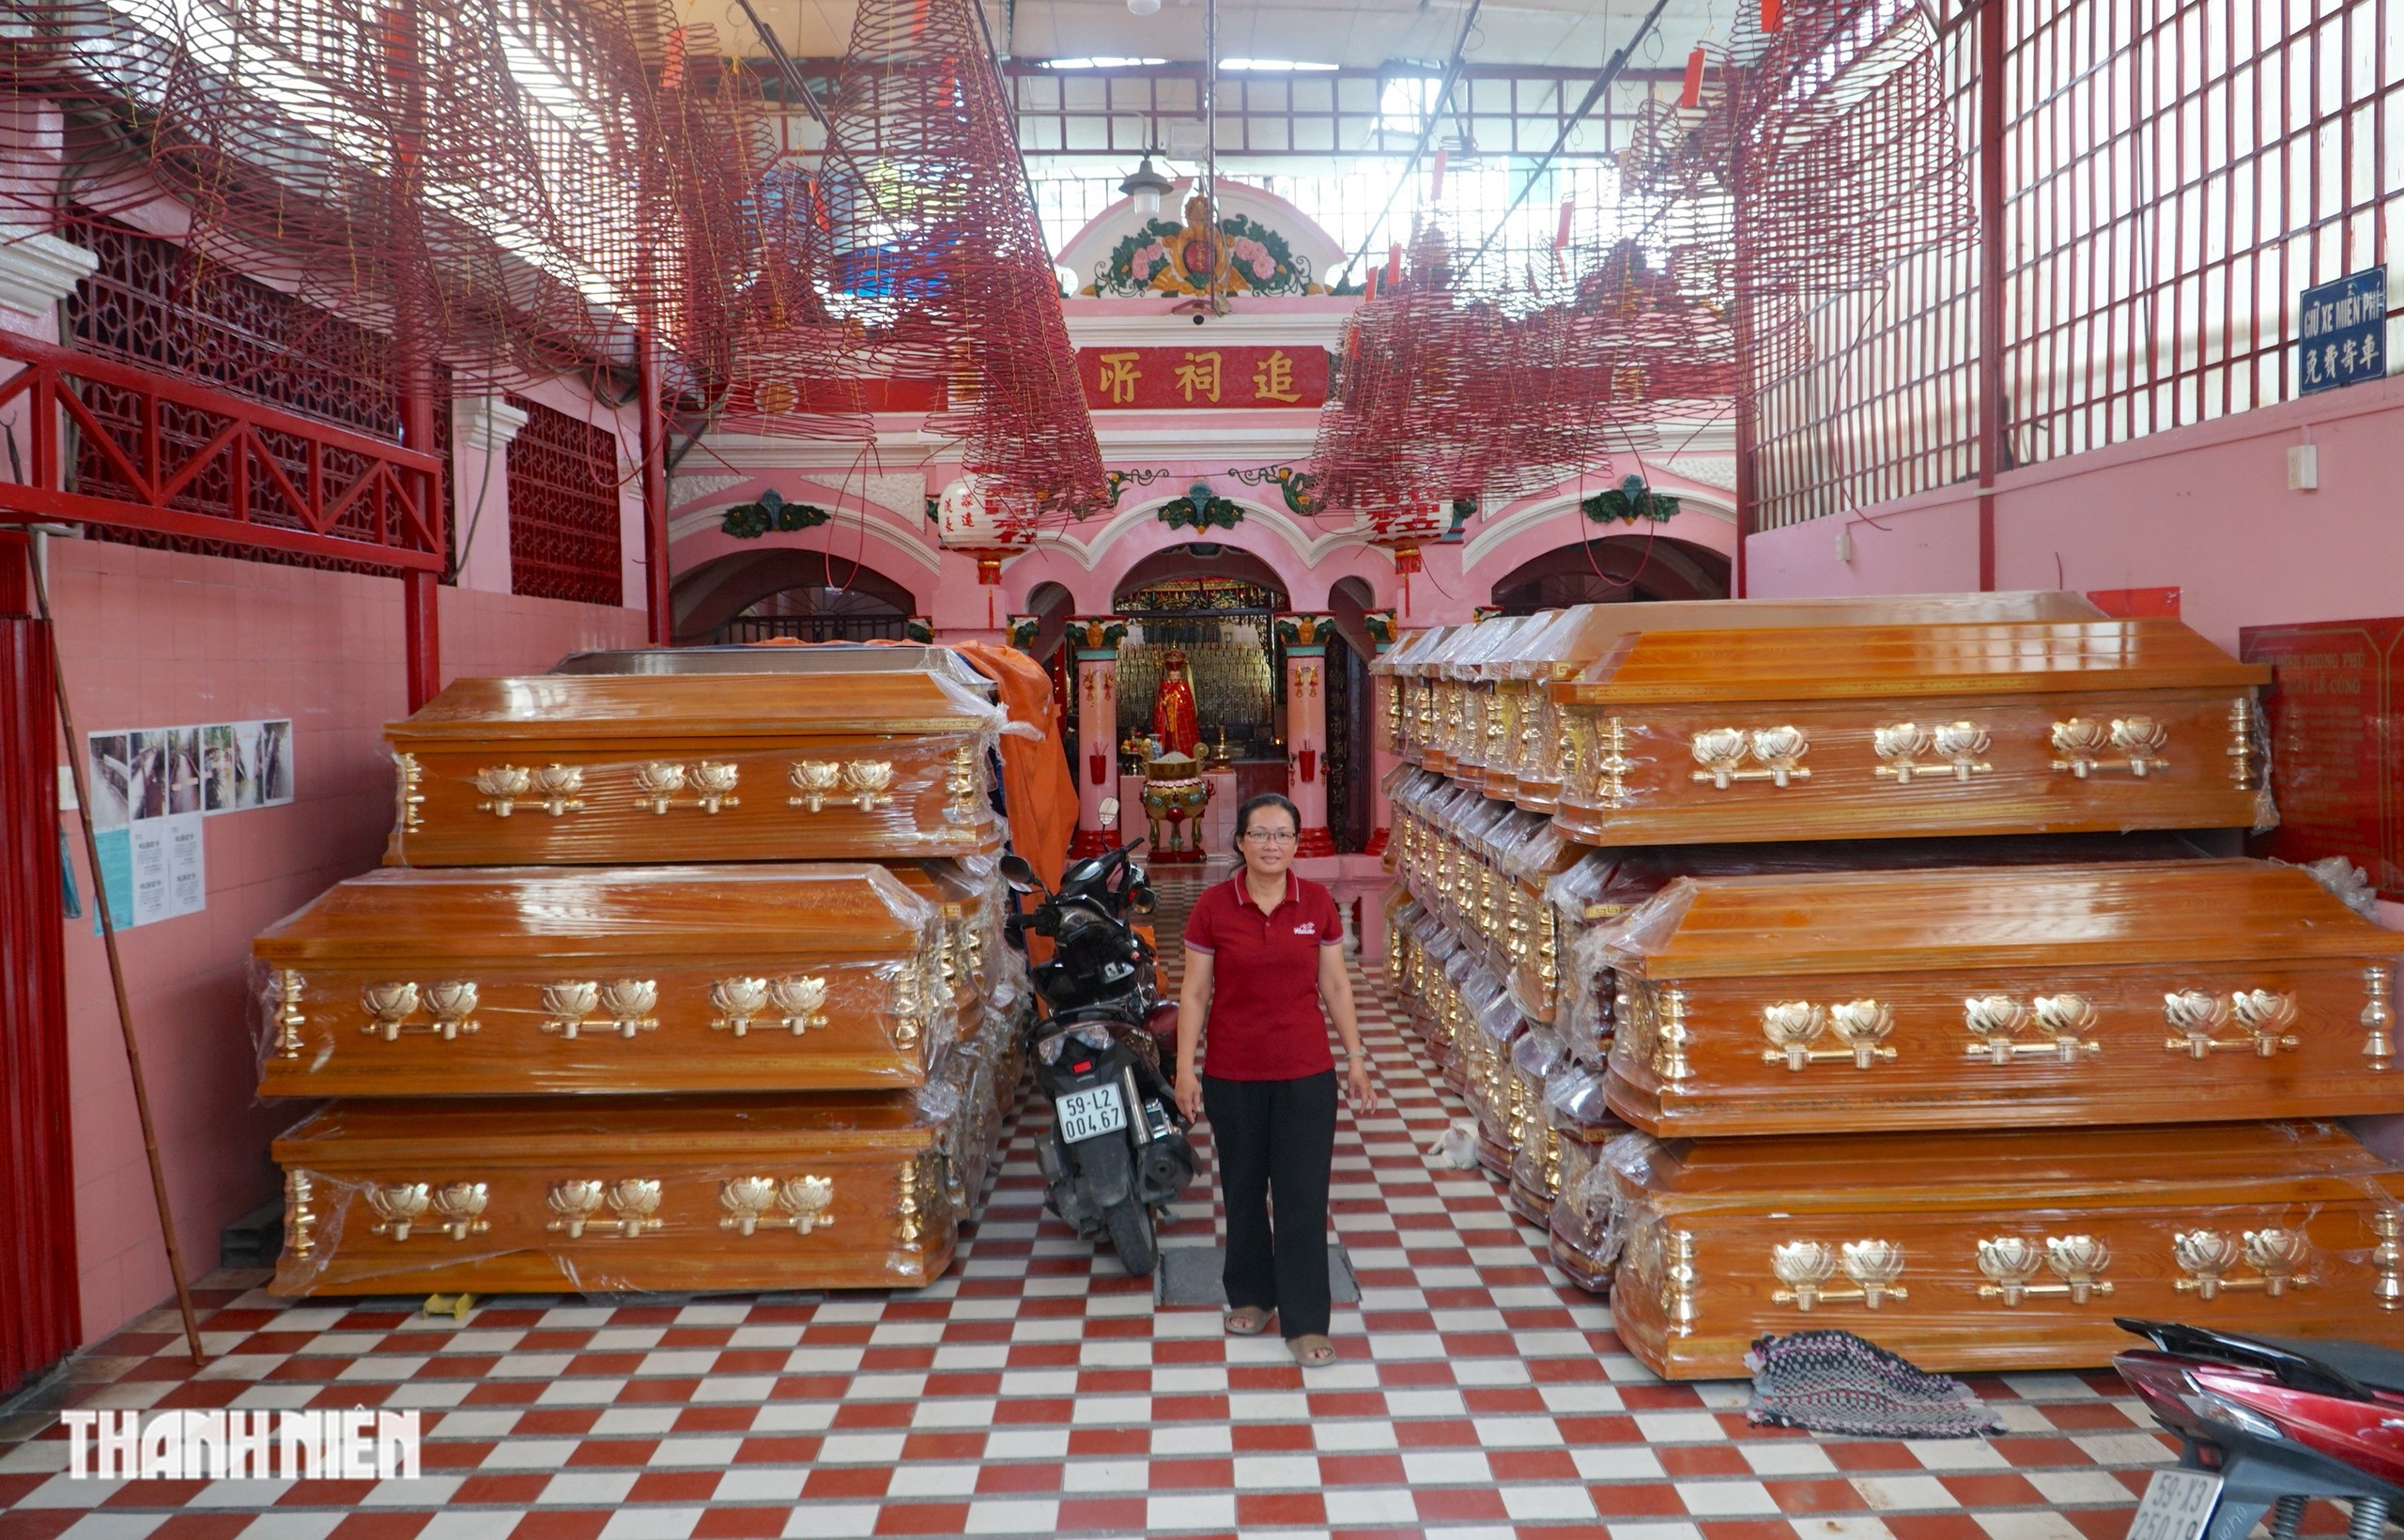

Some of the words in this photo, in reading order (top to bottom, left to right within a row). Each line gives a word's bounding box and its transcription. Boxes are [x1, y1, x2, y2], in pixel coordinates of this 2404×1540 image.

[2321, 303, 2334, 334] XE
[2363, 281, 2380, 322] PHÍ
[2304, 333, 2380, 384] 免費寄車
[1067, 1089, 1111, 1116] 59-L2
[1066, 1107, 1118, 1138] 004.67
[2152, 1474, 2208, 1513] 59-X3
